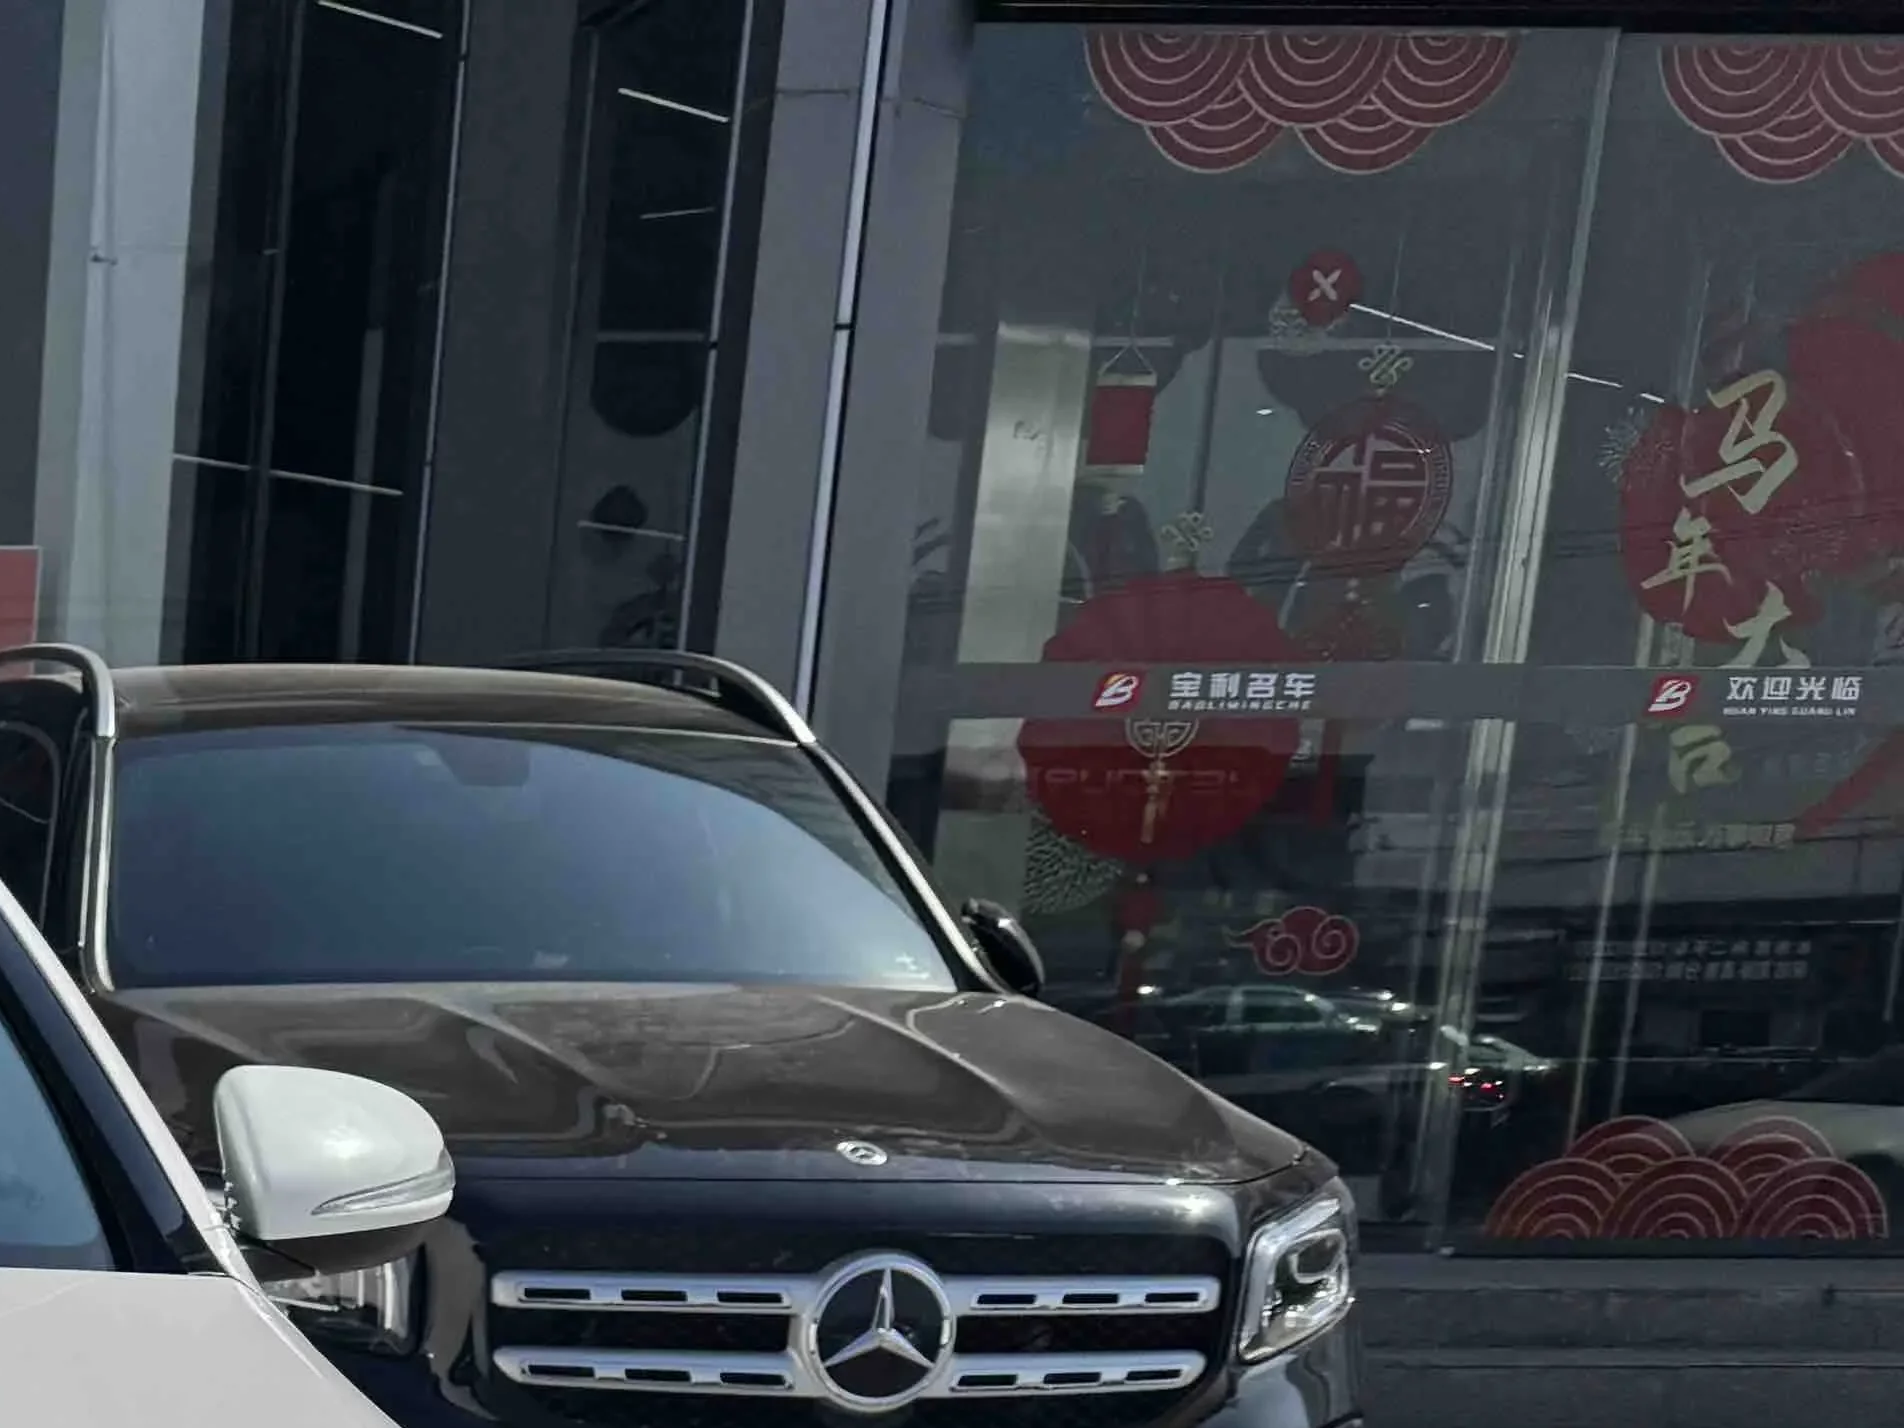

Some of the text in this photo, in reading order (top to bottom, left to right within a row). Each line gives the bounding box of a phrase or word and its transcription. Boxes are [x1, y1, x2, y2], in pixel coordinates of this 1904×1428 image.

[1169, 671, 1317, 699] 宝利名车
[1725, 675, 1863, 701] 欢迎光临
